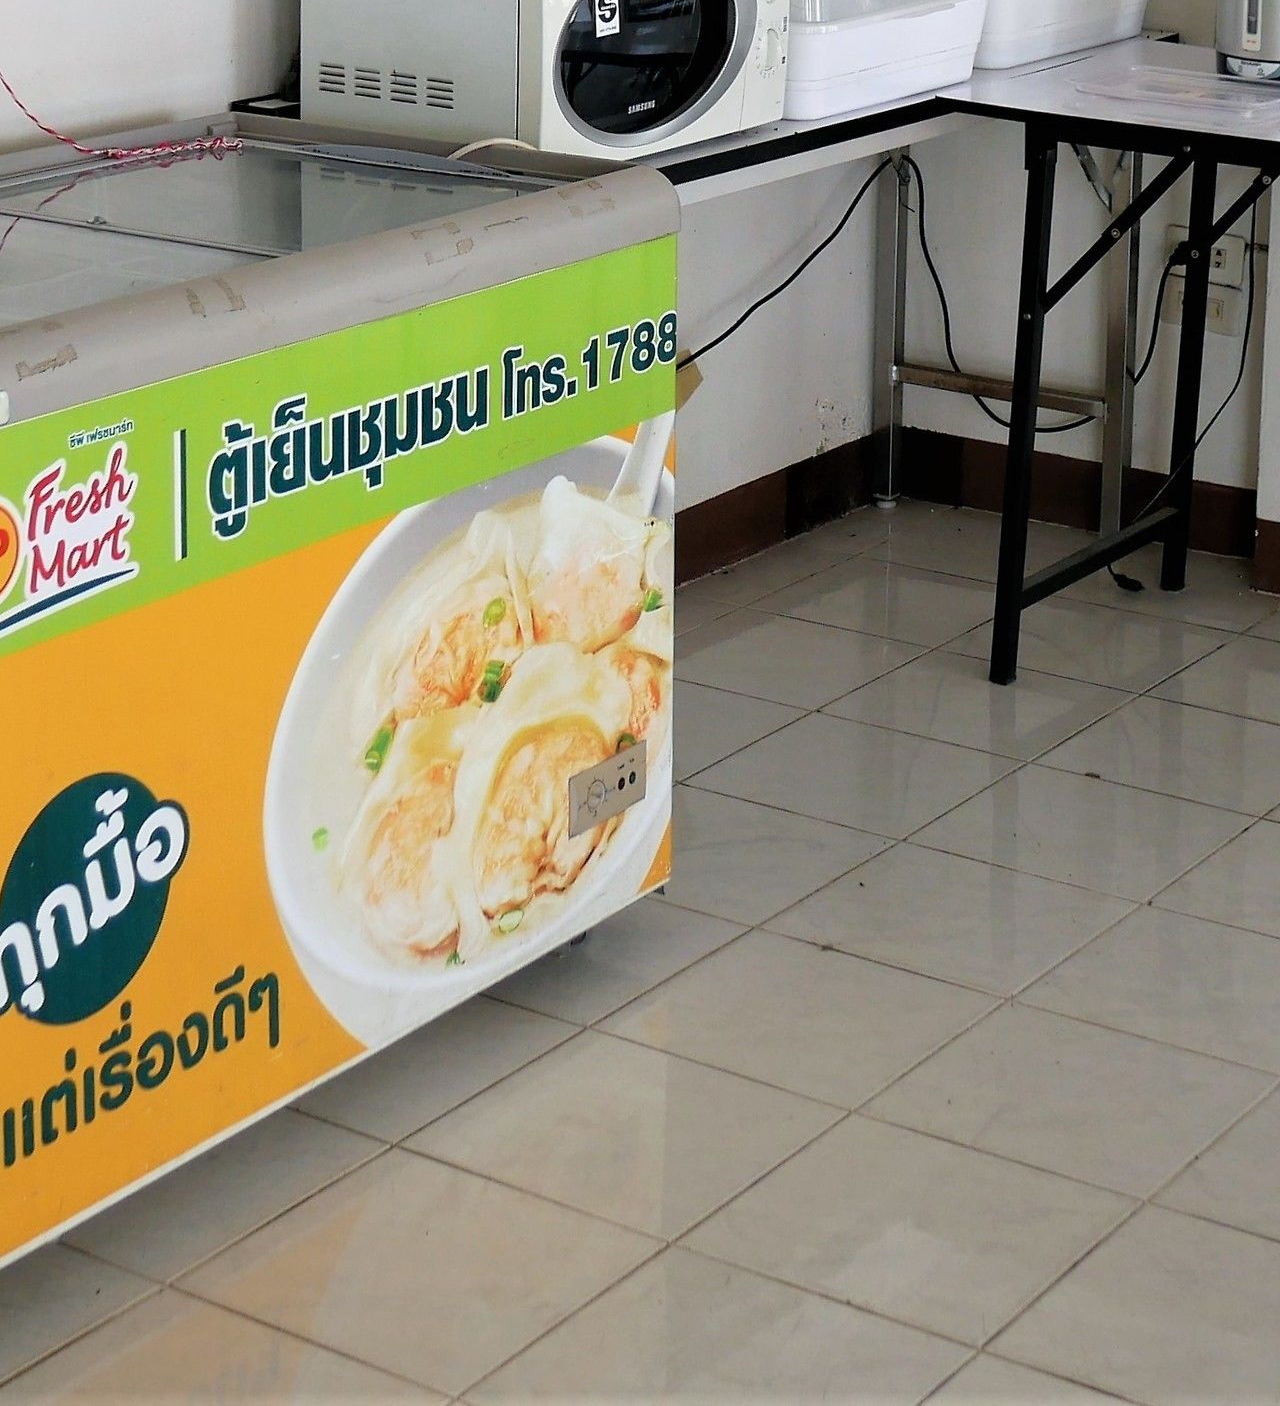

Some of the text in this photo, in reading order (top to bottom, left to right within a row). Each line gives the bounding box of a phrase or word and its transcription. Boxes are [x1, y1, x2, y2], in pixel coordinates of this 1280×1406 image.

[627, 99, 656, 115] SAMSUNG
[27, 448, 134, 542] Fresh
[208, 367, 489, 538] ตู้เย็นชุมชน
[29, 514, 130, 594] Mart
